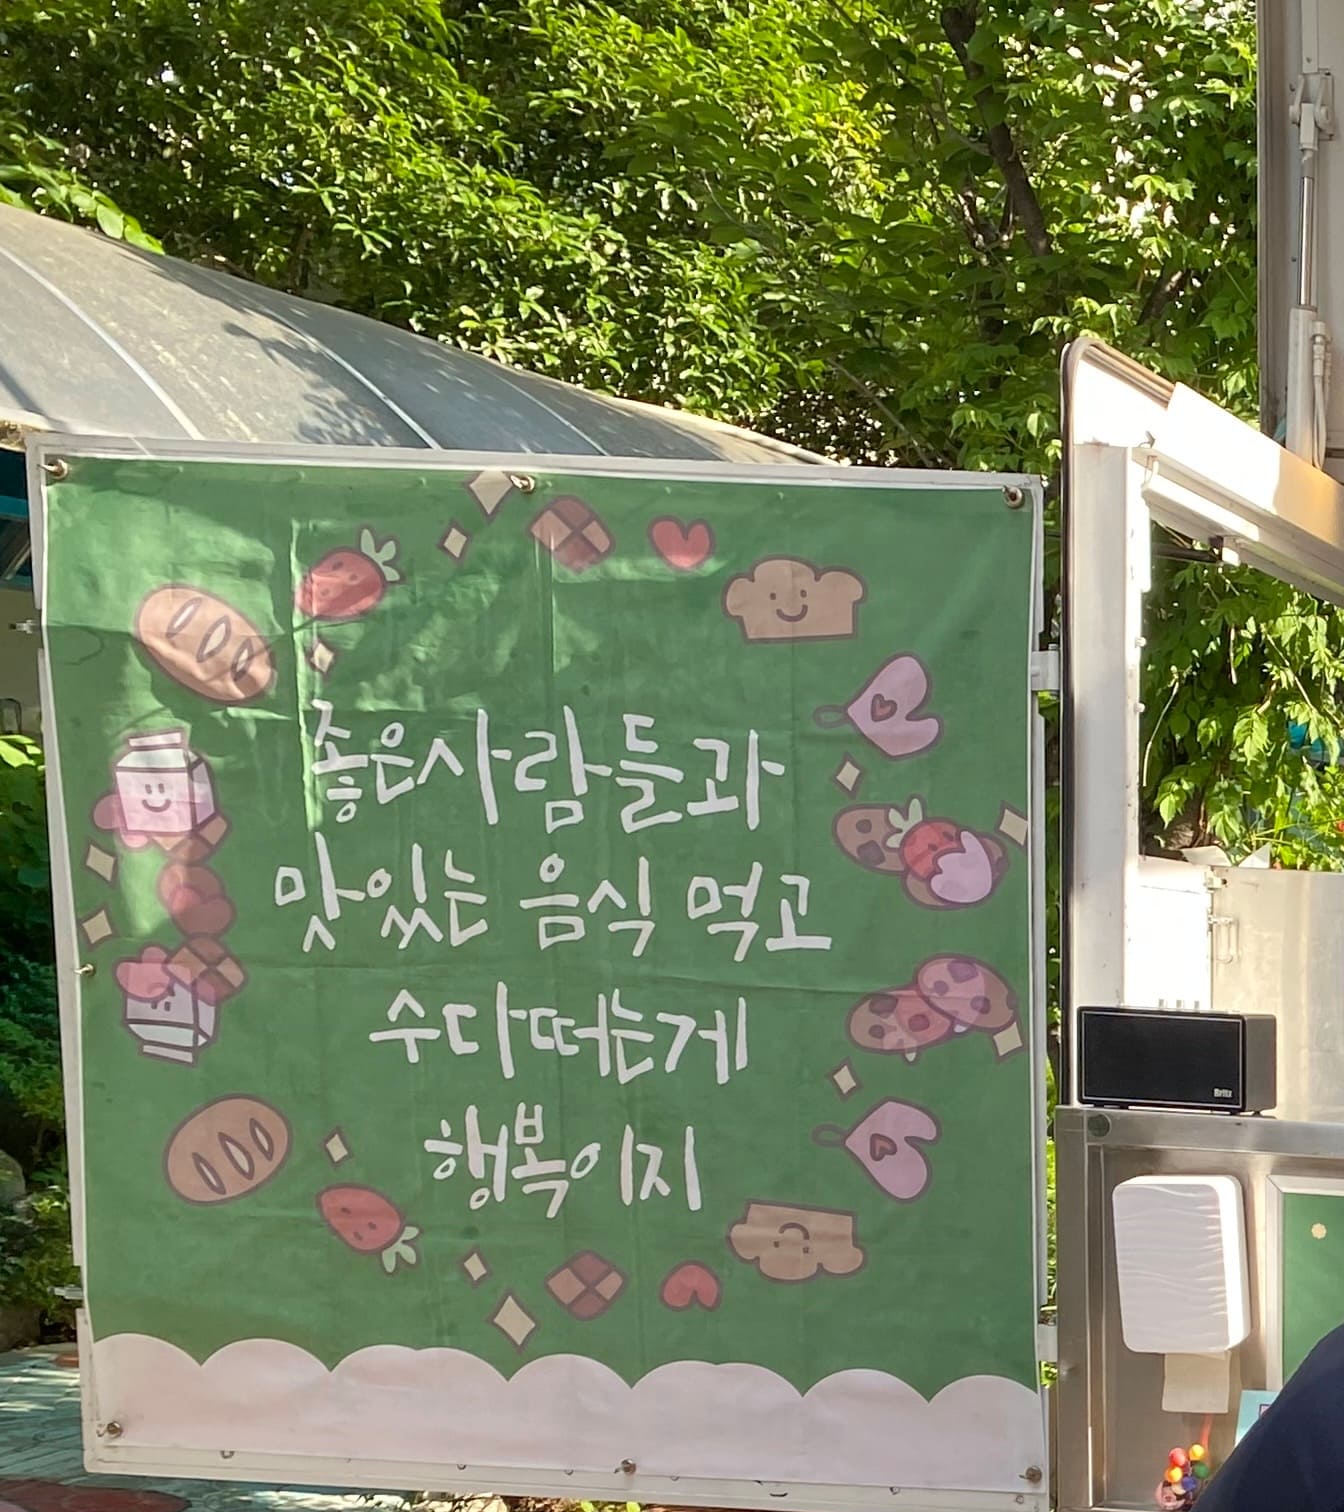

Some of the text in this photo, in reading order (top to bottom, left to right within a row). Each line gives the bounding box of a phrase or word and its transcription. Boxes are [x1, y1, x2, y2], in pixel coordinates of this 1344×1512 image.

[274, 831, 833, 963] 맛있는 음식 먹고
[368, 980, 748, 1085] 수다떠는게
[423, 1101, 702, 1219] 행복이지
